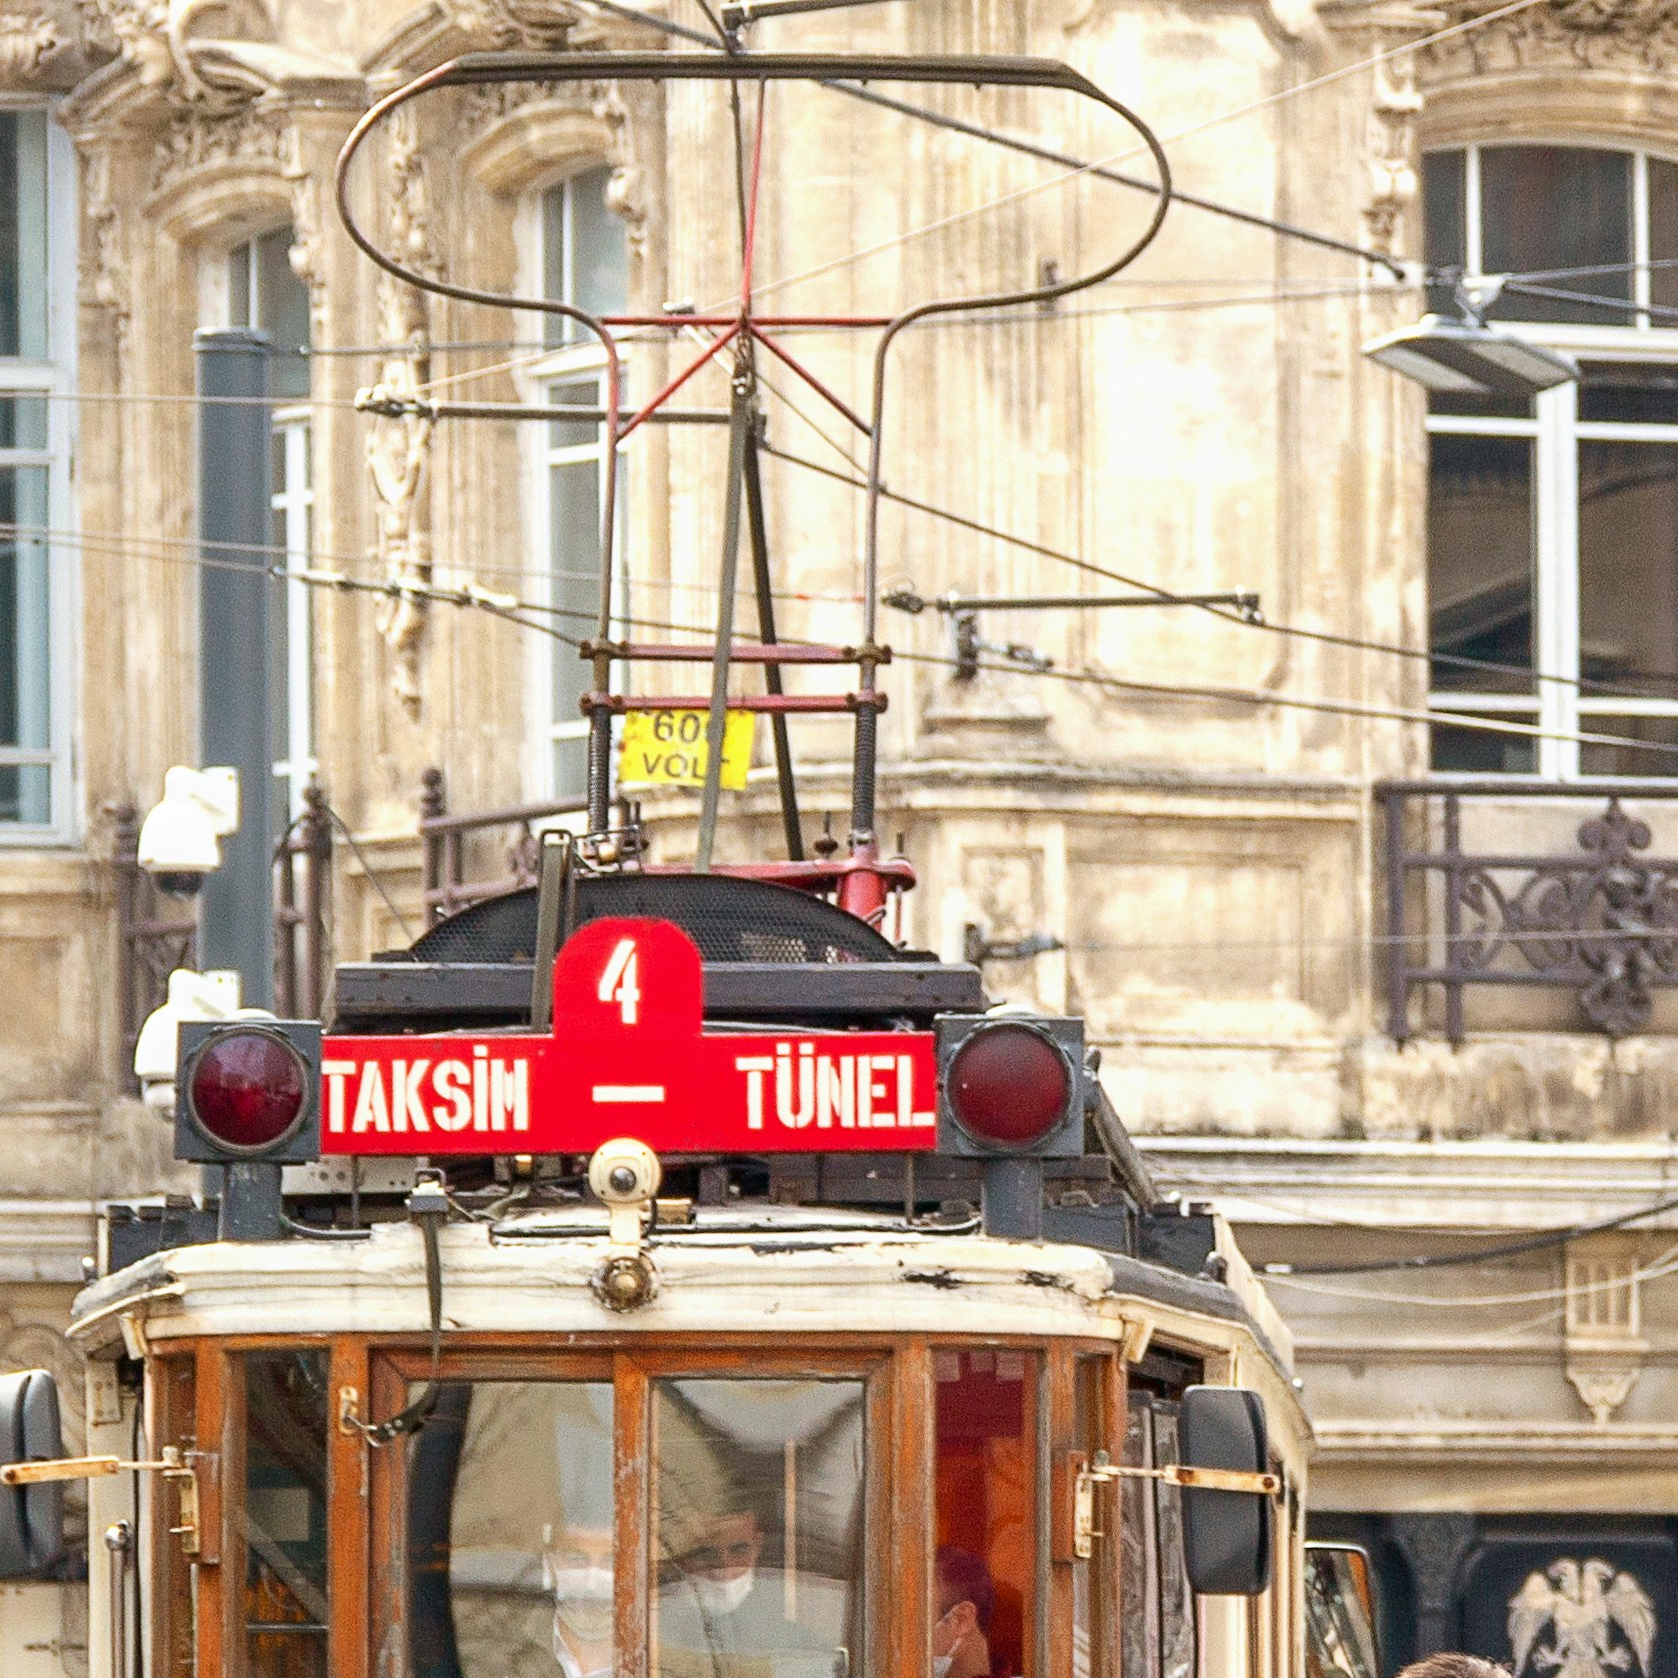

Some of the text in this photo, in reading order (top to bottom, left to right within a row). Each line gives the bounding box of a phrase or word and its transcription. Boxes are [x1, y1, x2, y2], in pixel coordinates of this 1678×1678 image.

[654, 709, 727, 744] 60
[642, 752, 730, 780] VOL
[597, 939, 640, 1026] 4
[321, 1044, 529, 1133] TAKSİM
[735, 1042, 935, 1130] TÜNEL
